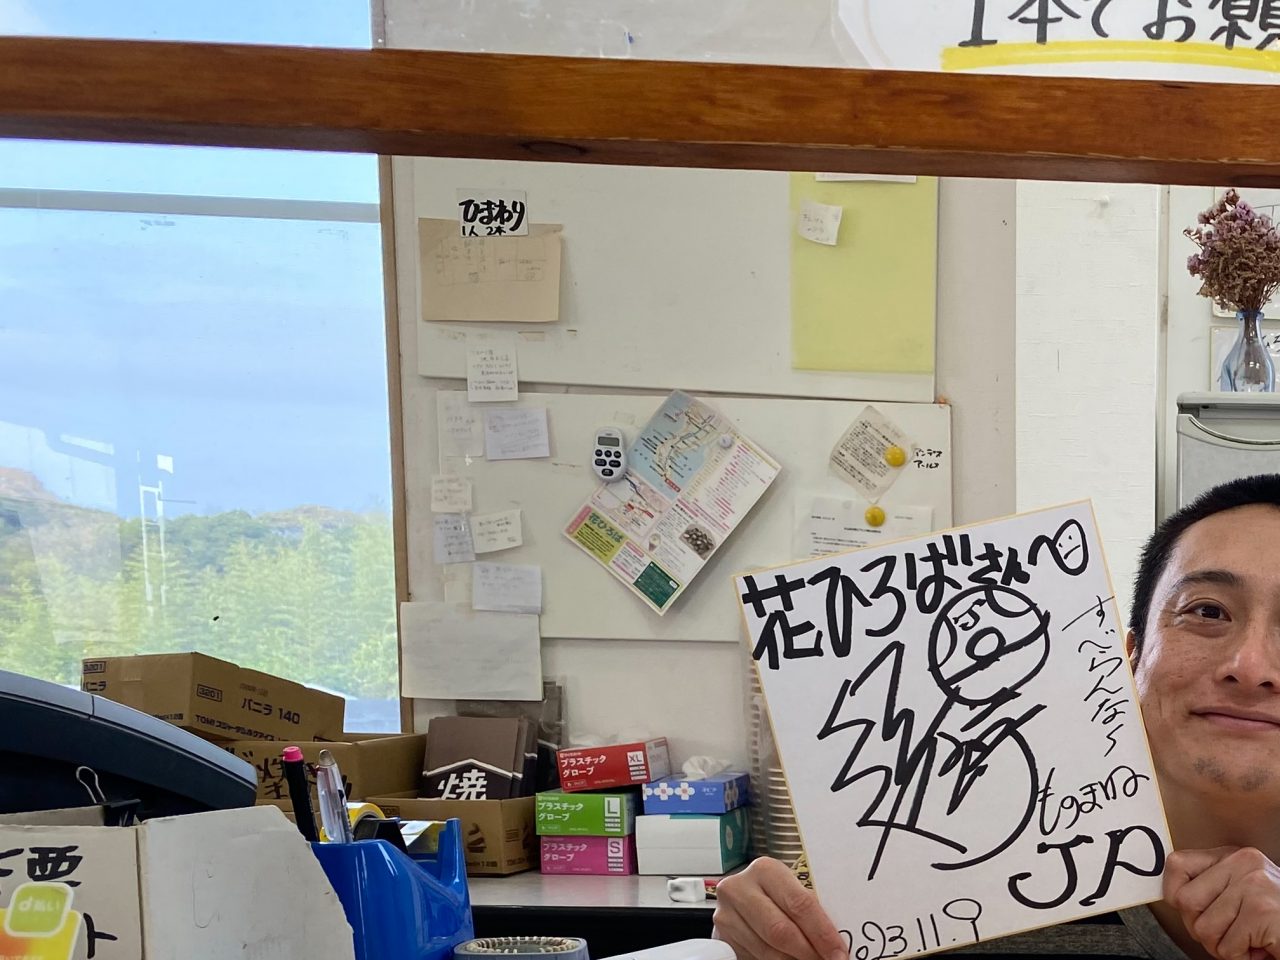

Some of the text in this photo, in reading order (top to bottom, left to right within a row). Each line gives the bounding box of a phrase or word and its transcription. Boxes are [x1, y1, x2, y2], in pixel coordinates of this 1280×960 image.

[458, 199, 526, 231] ひまわり
[742, 533, 1066, 670] 花ひろばさんへ
[241, 698, 301, 725] バニラ 140
[560, 753, 644, 768] プラスチック XL
[562, 766, 595, 778] グローブ
[537, 799, 618, 814] プラスチック L
[537, 812, 571, 822] グローブ
[542, 840, 621, 854] プラスチック S
[543, 852, 575, 862] グローブ
